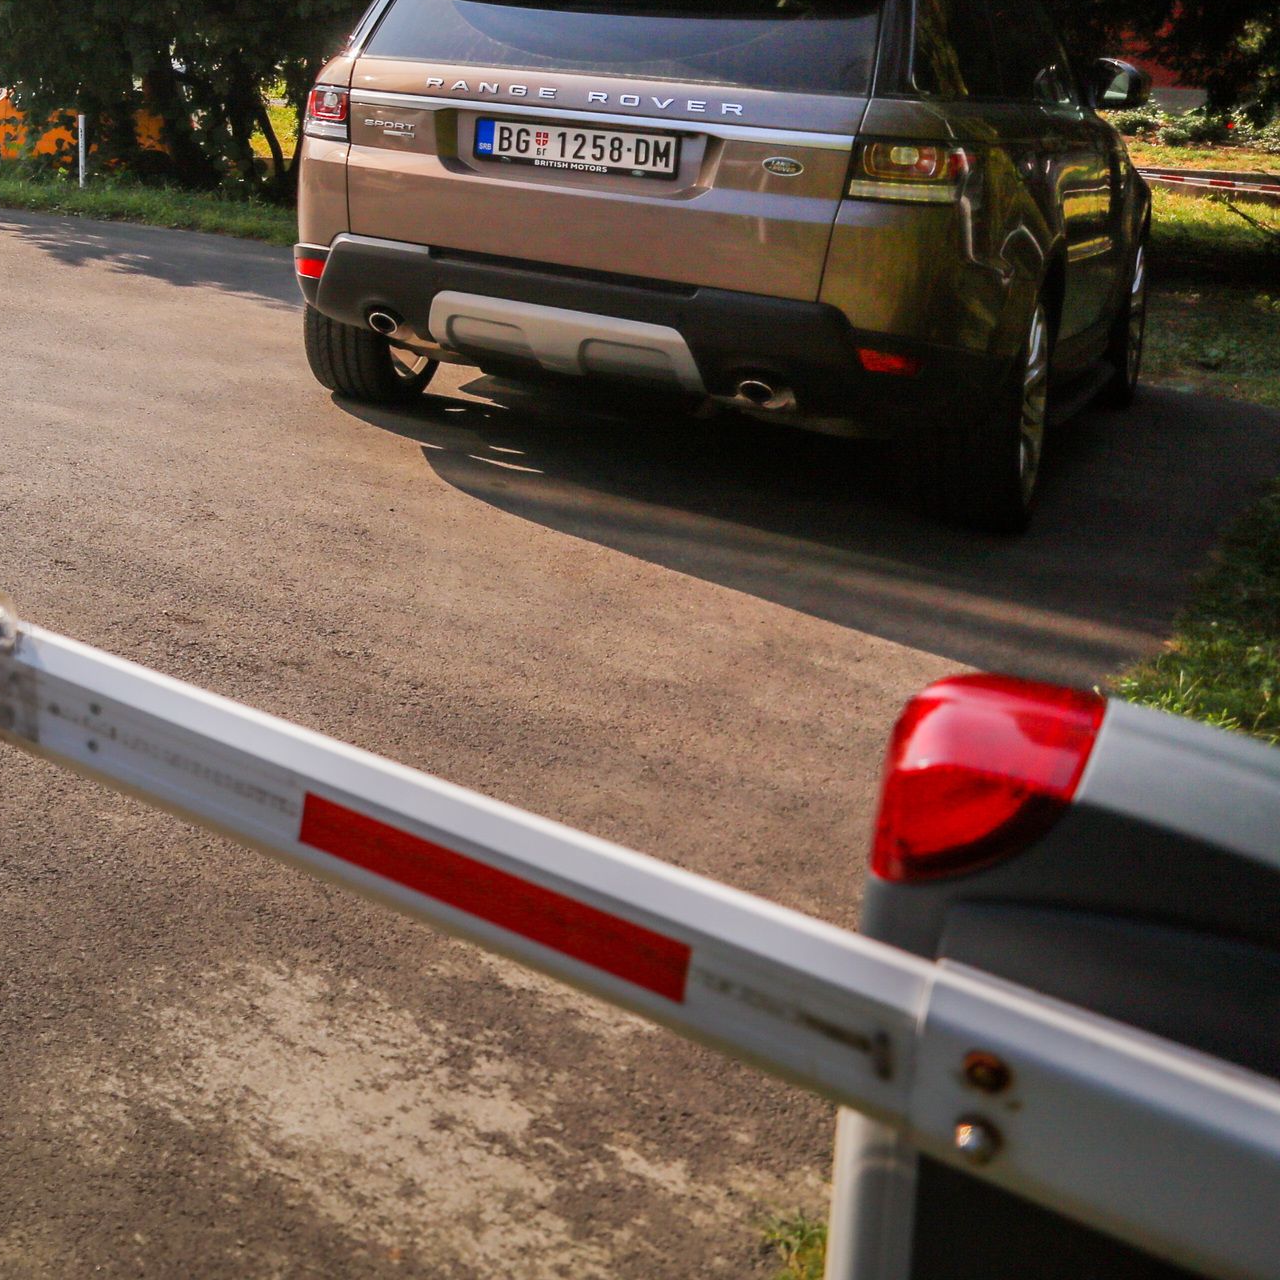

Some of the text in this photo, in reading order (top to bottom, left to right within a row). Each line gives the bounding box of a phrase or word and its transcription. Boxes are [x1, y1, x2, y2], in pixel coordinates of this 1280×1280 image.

[426, 77, 744, 117] RANGE ROVER
[364, 118, 416, 131] SPORT
[478, 142, 492, 151] SRB
[498, 126, 531, 154] BG
[534, 159, 608, 173] BRITISH MOTORS
